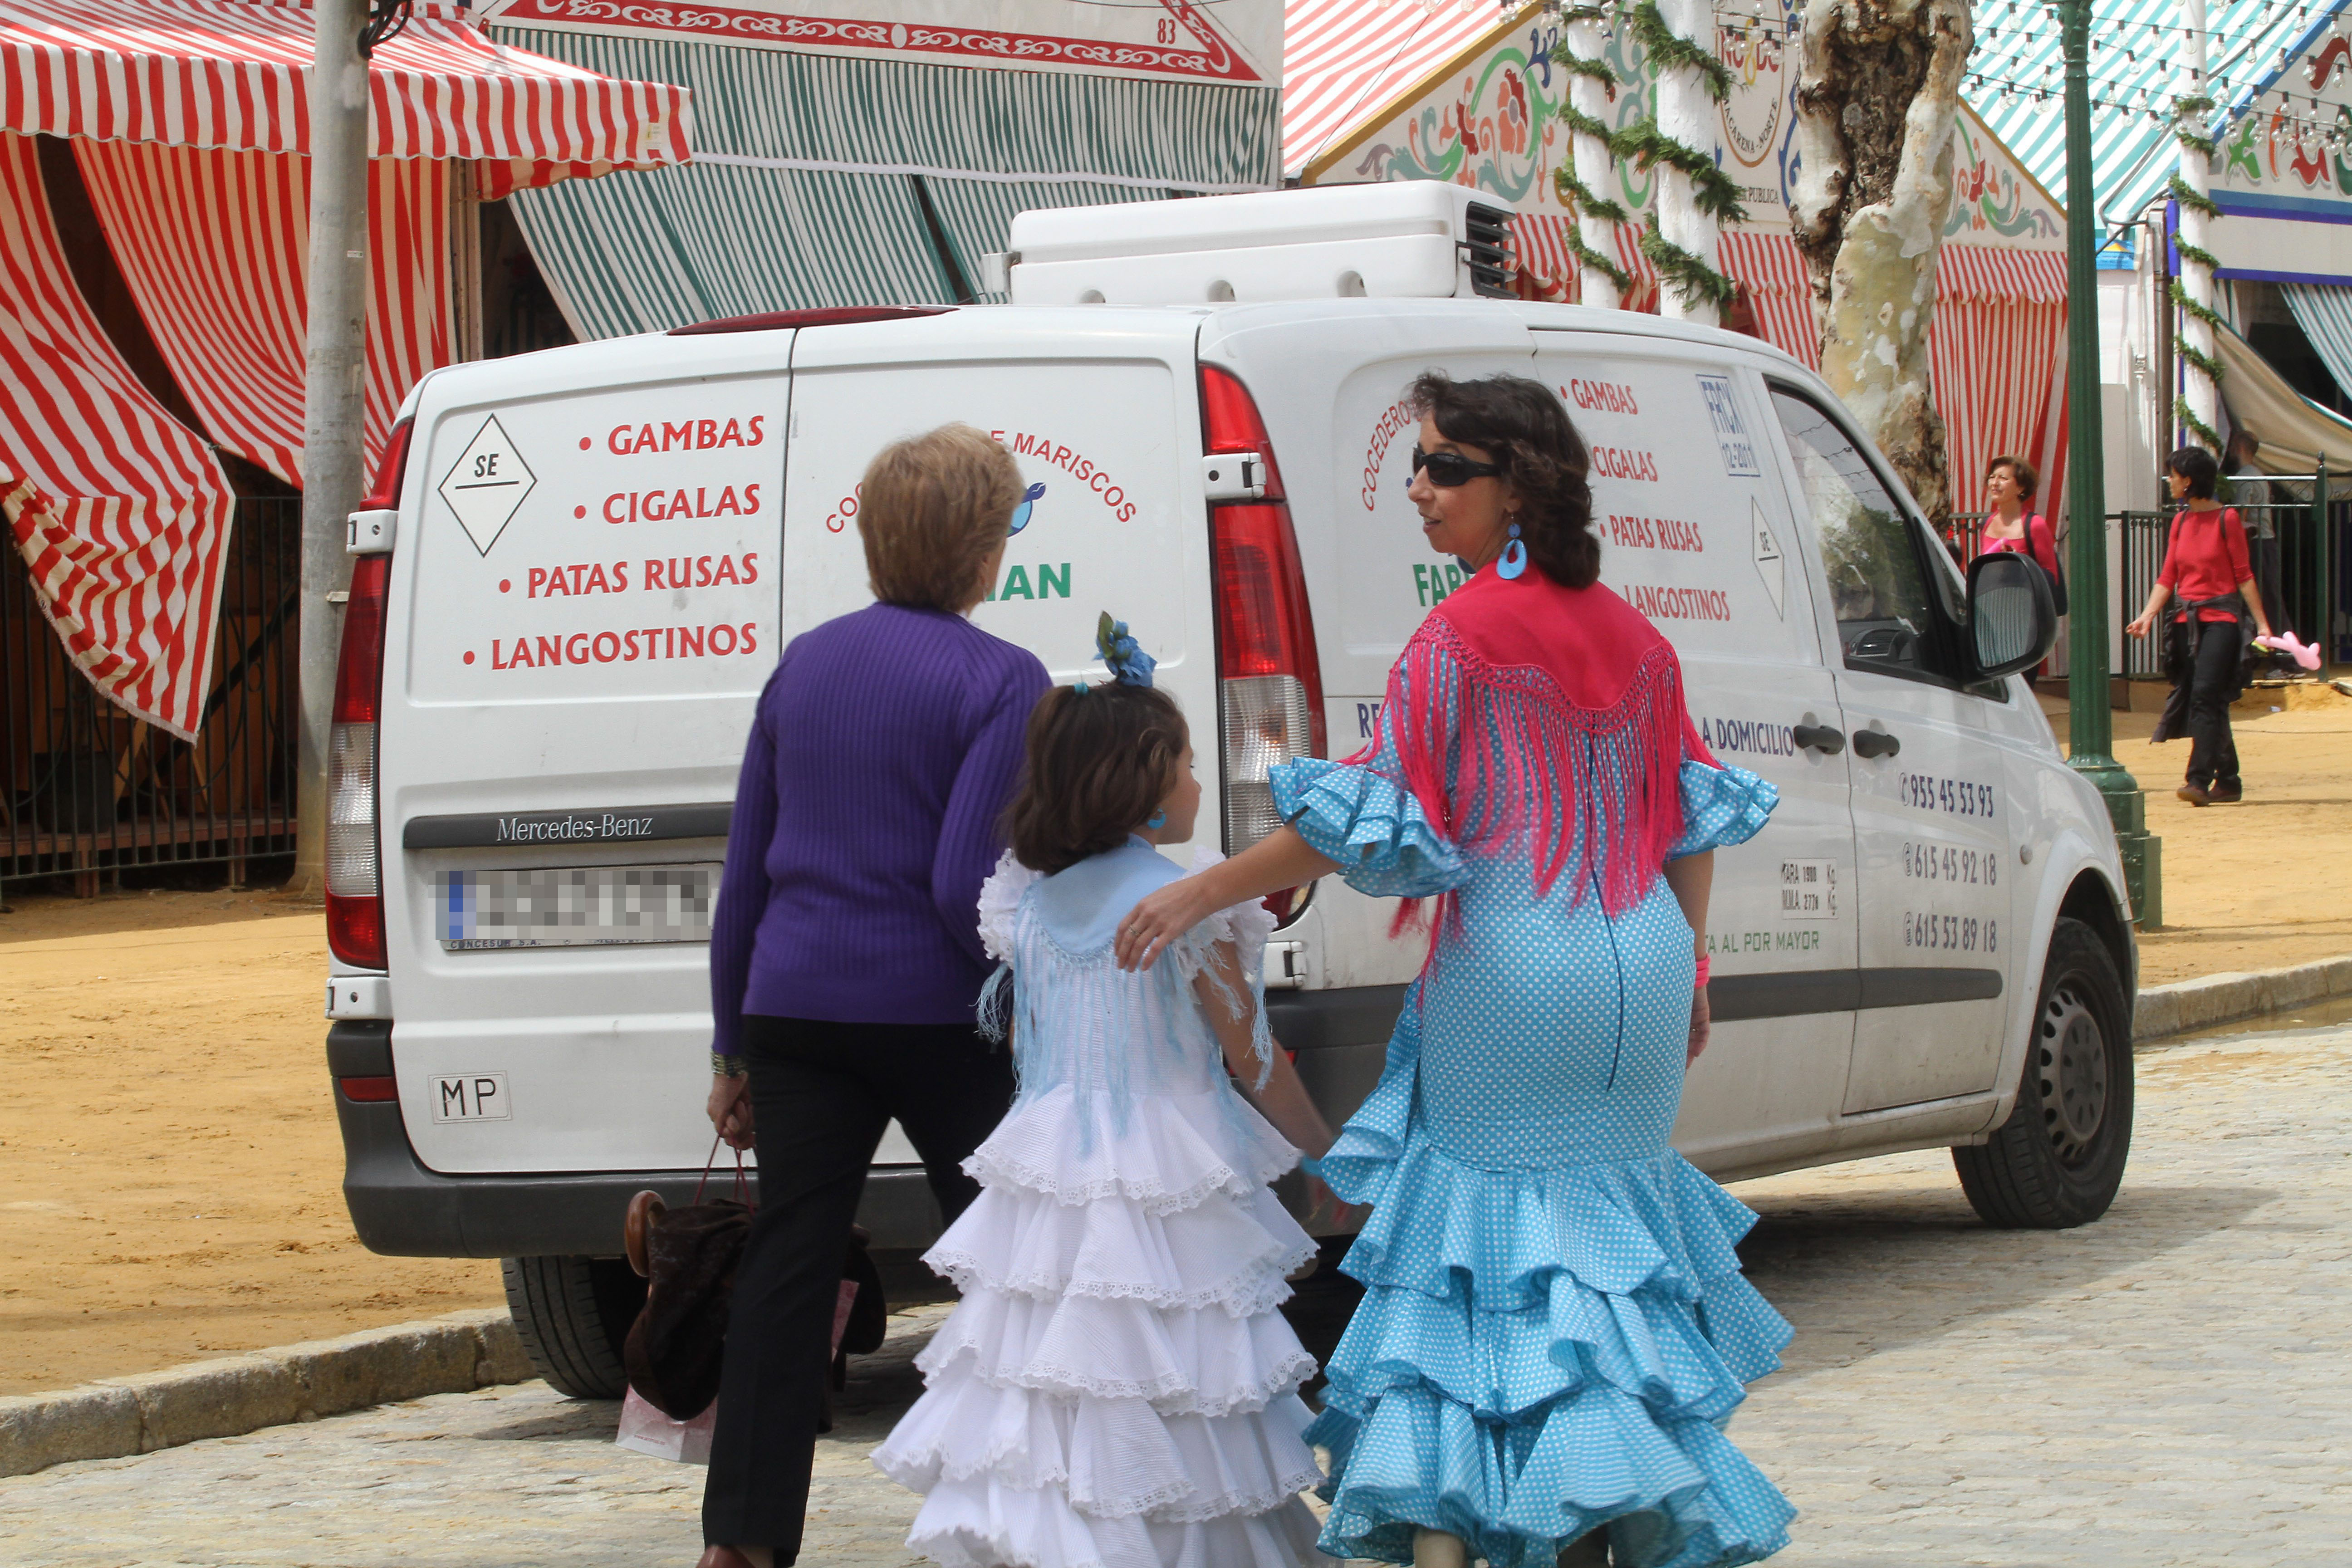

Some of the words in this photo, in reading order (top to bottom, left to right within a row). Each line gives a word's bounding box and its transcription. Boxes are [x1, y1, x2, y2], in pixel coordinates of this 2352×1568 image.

[1157, 18, 1176, 44] 83
[1571, 378, 1638, 415] GAMBAS
[608, 415, 764, 455] GAMBAS
[474, 453, 499, 478] SE
[1014, 432, 1136, 522] MARISCOS
[1592, 446, 1658, 482] CIGALAS
[603, 484, 760, 524] CIGALAS
[1609, 515, 1655, 549] PATAS
[1656, 519, 1703, 553] RUSAS
[527, 561, 628, 599] PATAS
[644, 553, 758, 591] RUSAS
[491, 623, 757, 670] LANGOSTINOS
[1703, 717, 1713, 748] A
[1716, 718, 1794, 757] DOMICILIO
[1911, 774, 1935, 809] 955
[1940, 779, 1955, 813] 45
[1959, 782, 1974, 815] 53
[1978, 784, 1993, 818] 93
[497, 814, 653, 841] Mercedes-Benz
[1915, 844, 1937, 879] 615
[1942, 848, 1957, 882] 45
[1962, 850, 1977, 883] 92
[1982, 853, 1996, 886] 18
[1722, 934, 1738, 953] AL
[1744, 932, 1770, 951] POR
[1776, 931, 1819, 951] MAYOR
[1915, 913, 1937, 948] 615
[1943, 916, 1958, 949] 53
[1963, 917, 1977, 951] 89
[1983, 920, 1996, 952] 18
